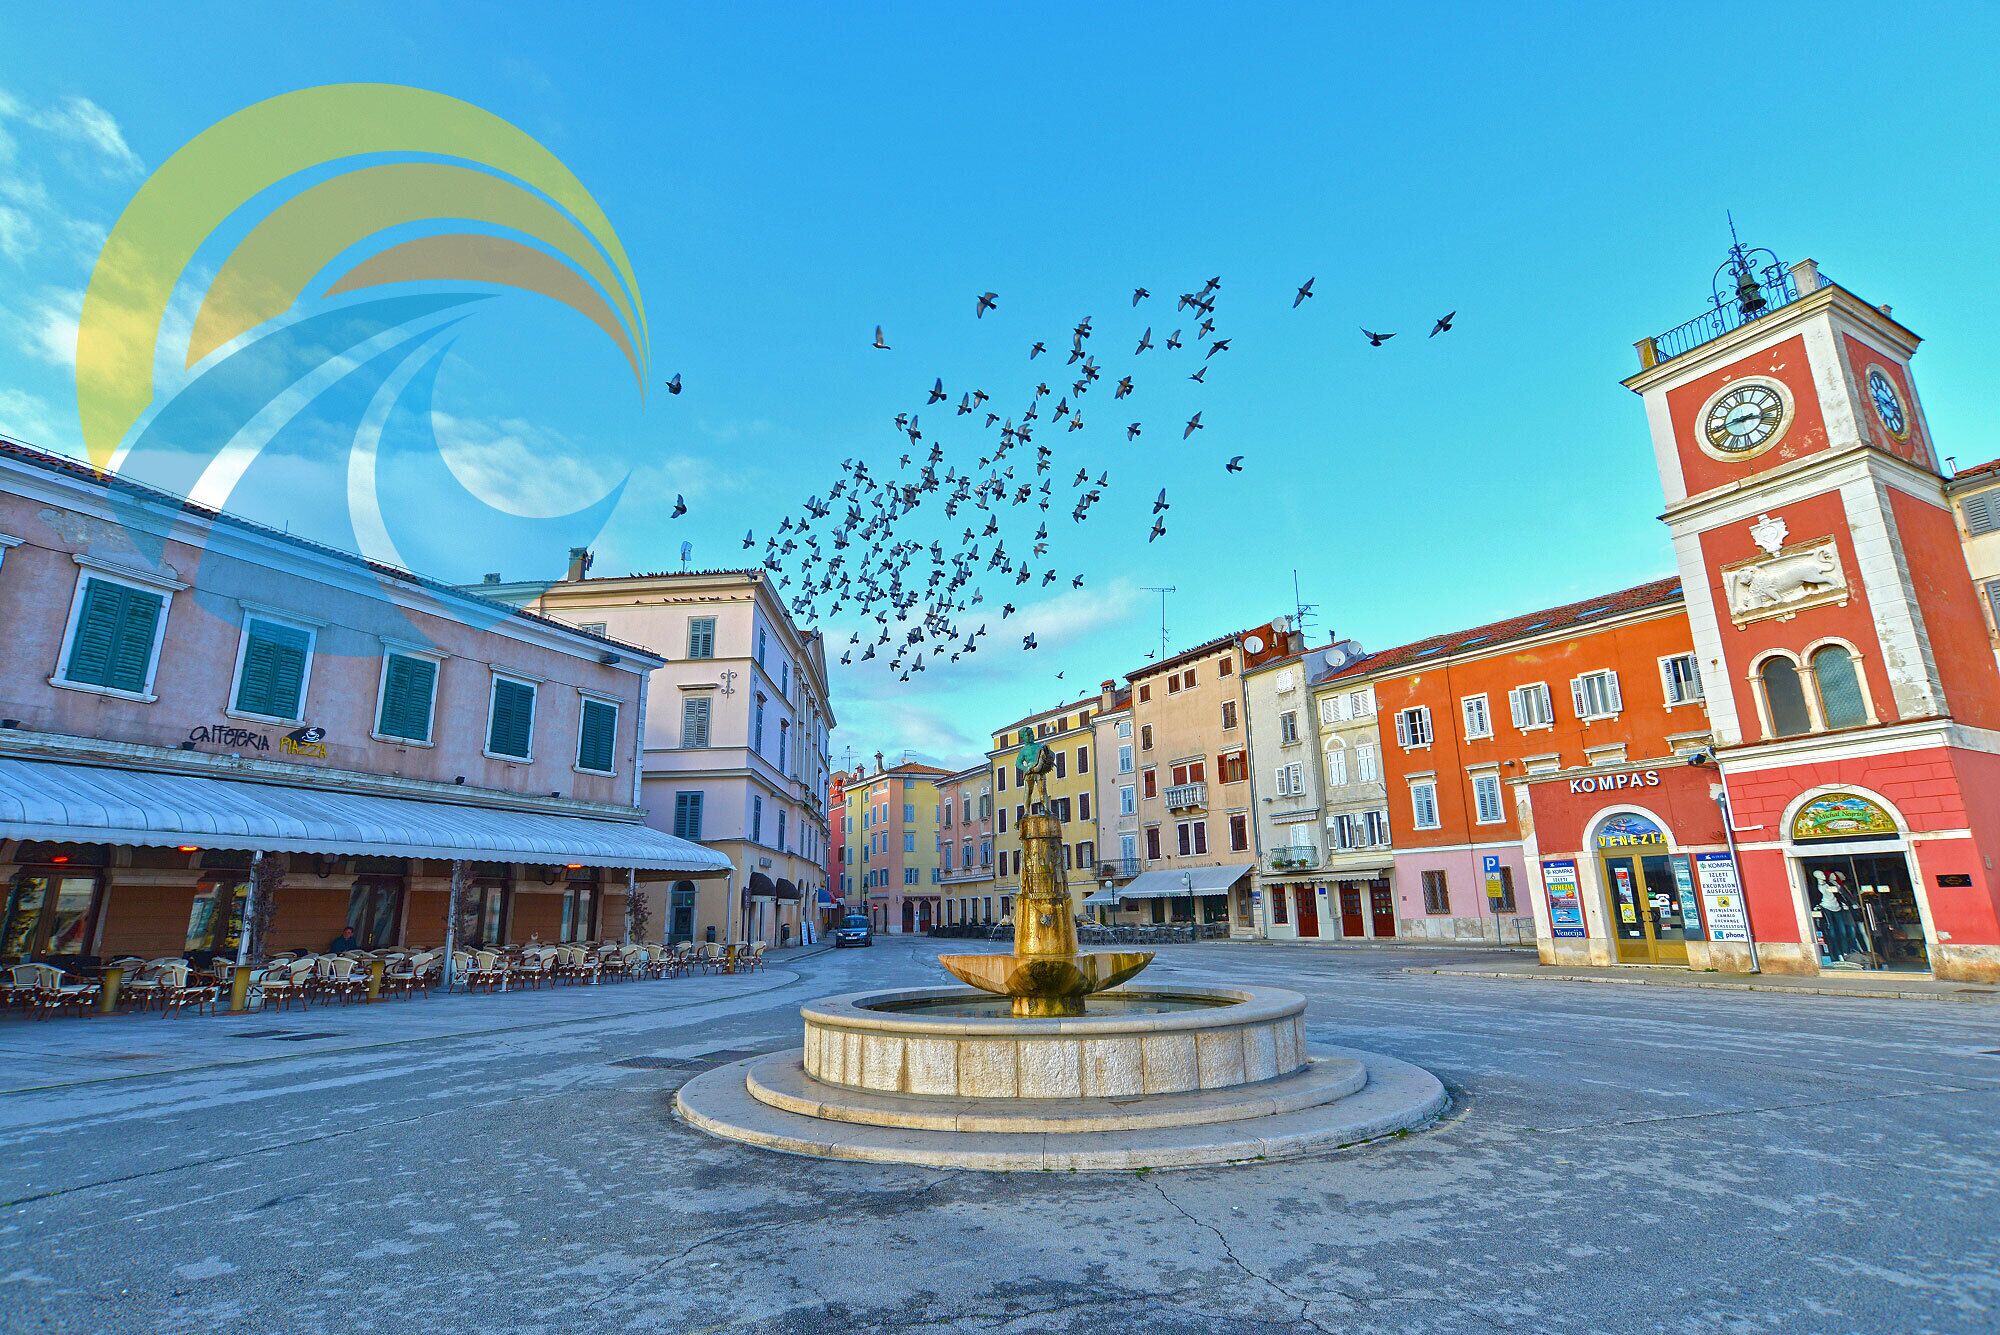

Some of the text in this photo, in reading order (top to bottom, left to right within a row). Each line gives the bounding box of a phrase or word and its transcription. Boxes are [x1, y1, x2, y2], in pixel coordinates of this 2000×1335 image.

[279, 735, 327, 759] PIAZZA
[1569, 770, 1660, 794] KOMPAS
[1597, 833, 1667, 847] VENEZIA
[1486, 858, 1496, 870] P
